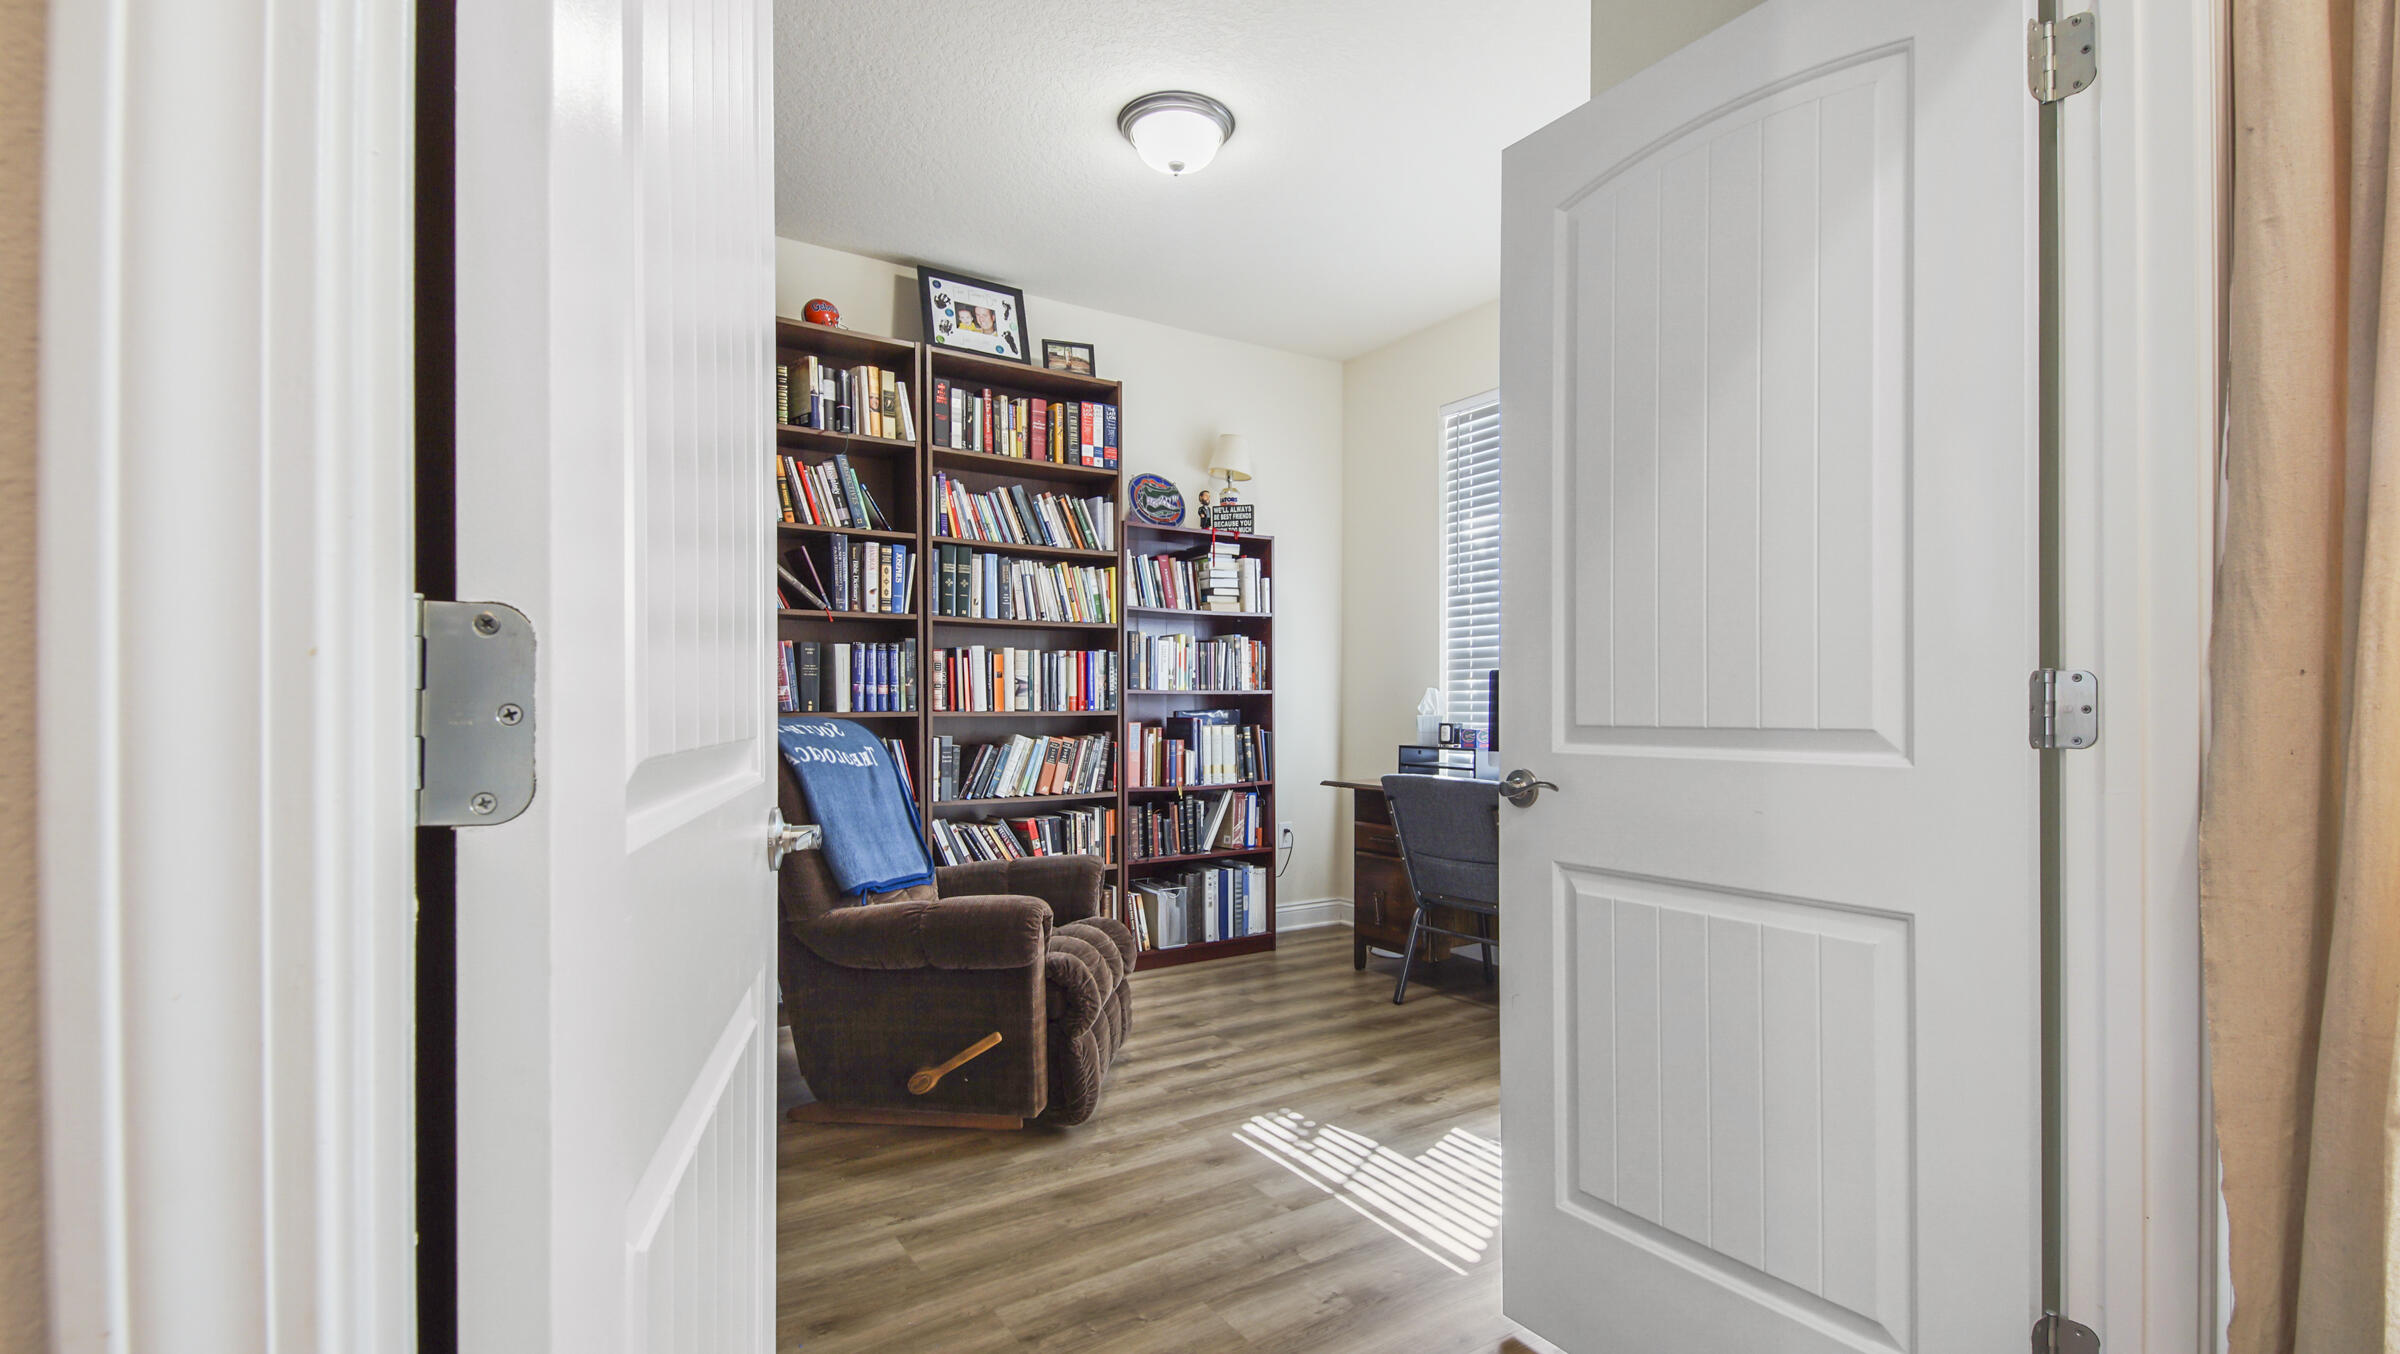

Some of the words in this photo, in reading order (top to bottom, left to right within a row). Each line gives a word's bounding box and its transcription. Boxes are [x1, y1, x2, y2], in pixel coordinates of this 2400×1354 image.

[1230, 505, 1252, 513] ALWAYS
[1213, 520, 1239, 528] BECAUSE
[1240, 519, 1252, 527] YOU
